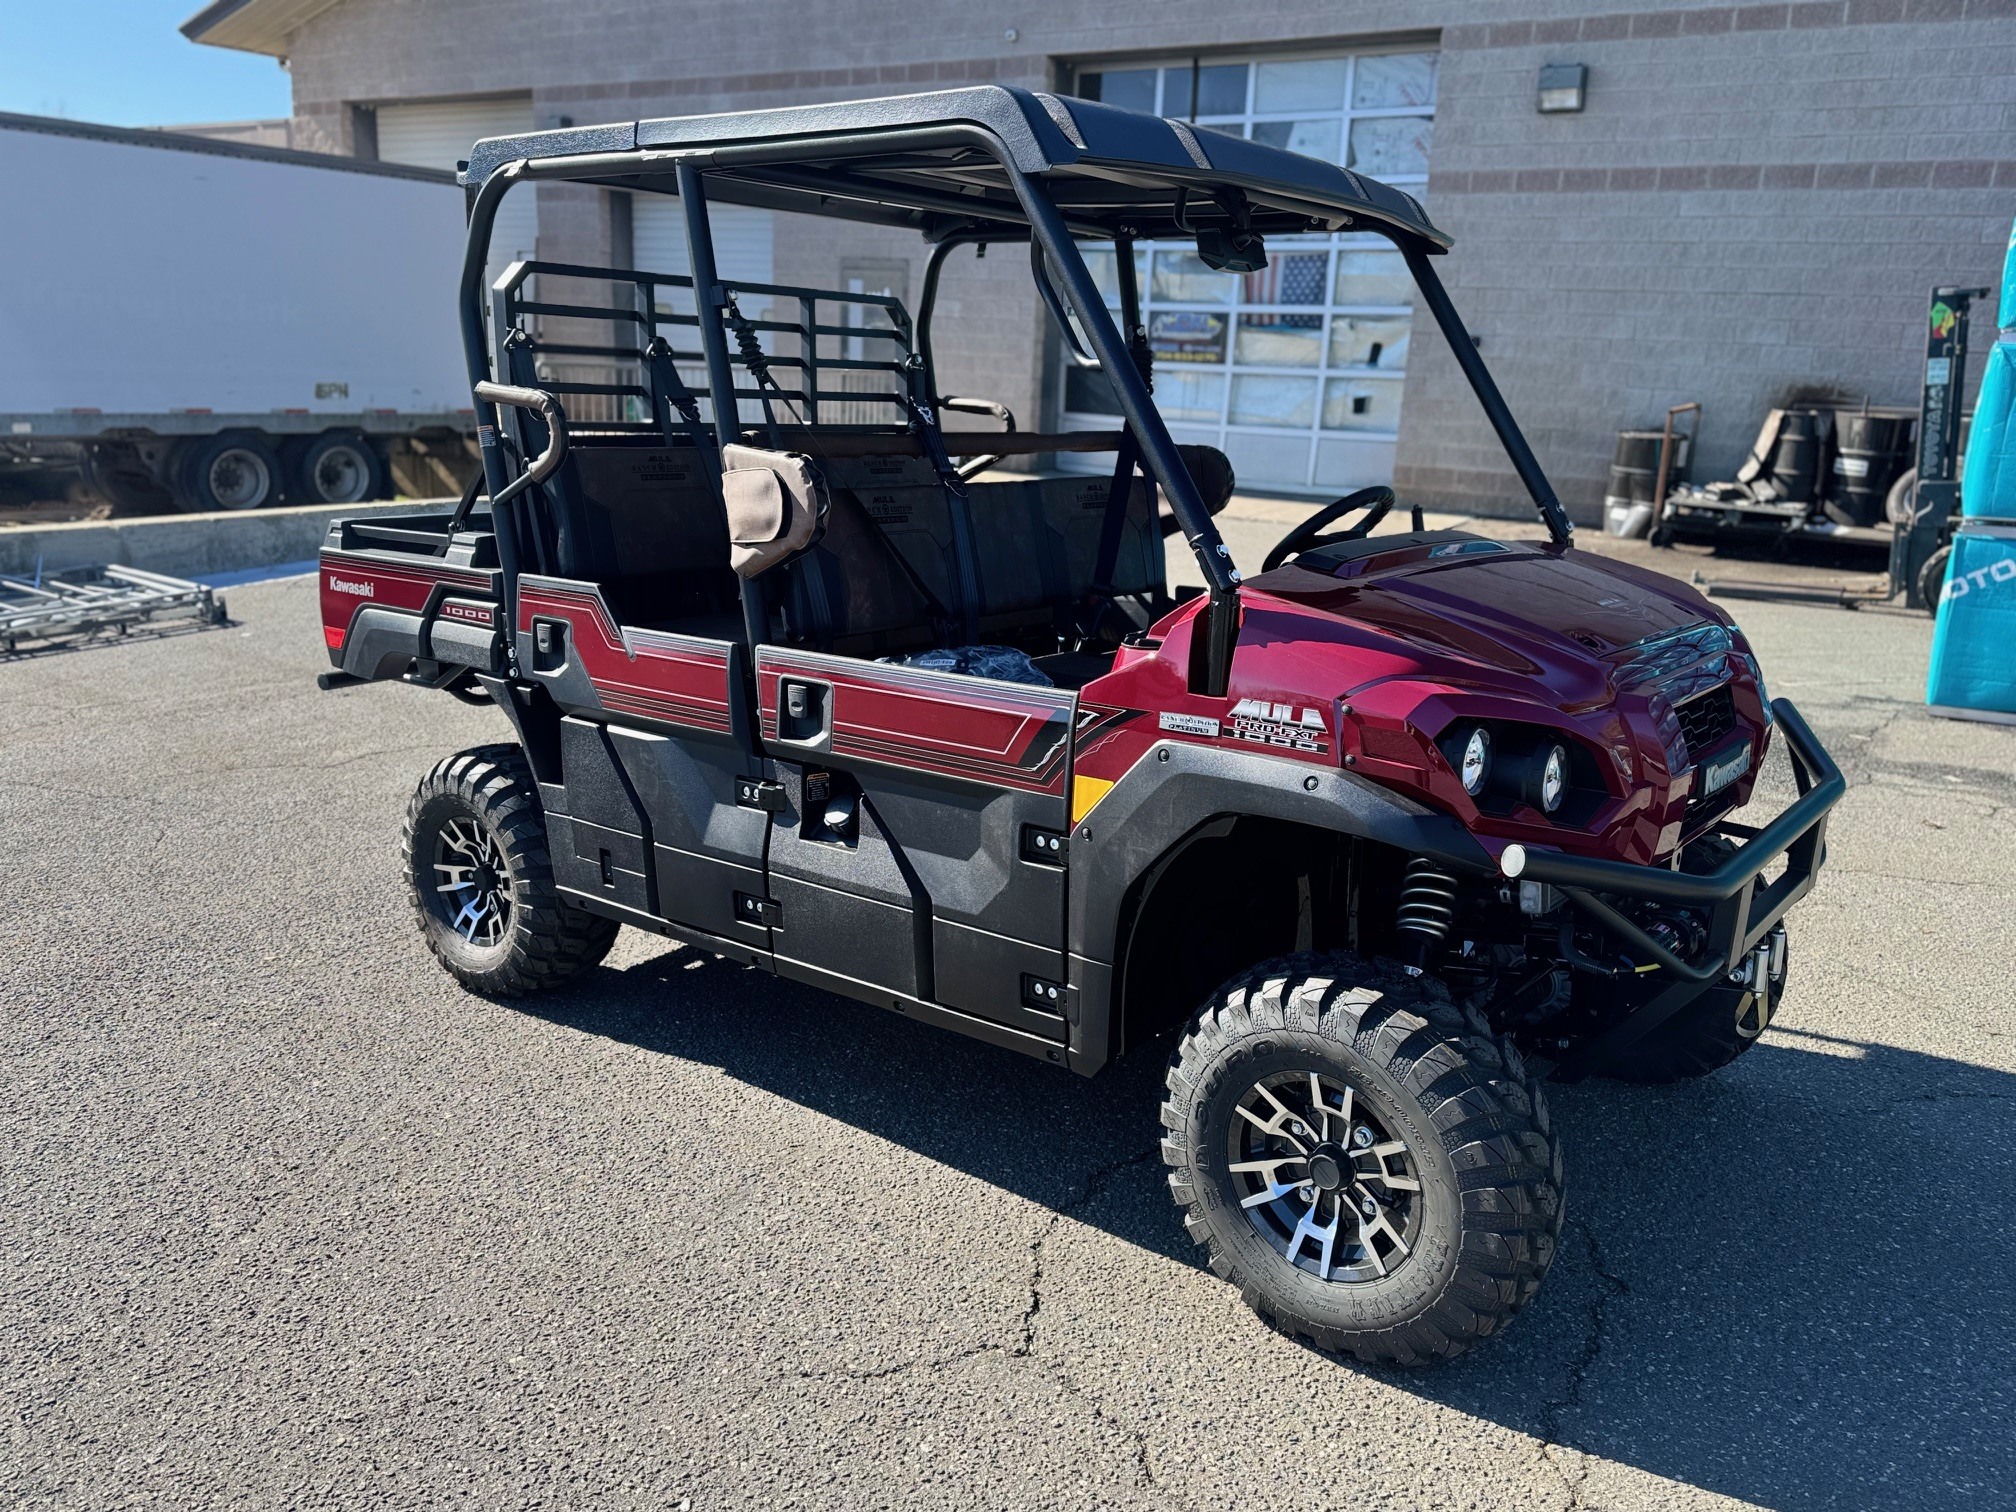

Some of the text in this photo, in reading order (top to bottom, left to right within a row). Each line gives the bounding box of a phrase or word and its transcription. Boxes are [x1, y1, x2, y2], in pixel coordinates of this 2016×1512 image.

[329, 576, 374, 597] Kawasaki
[445, 605, 491, 621] 1000
[1227, 698, 1329, 734] MULE
[1704, 741, 1752, 797] Kawasaki
